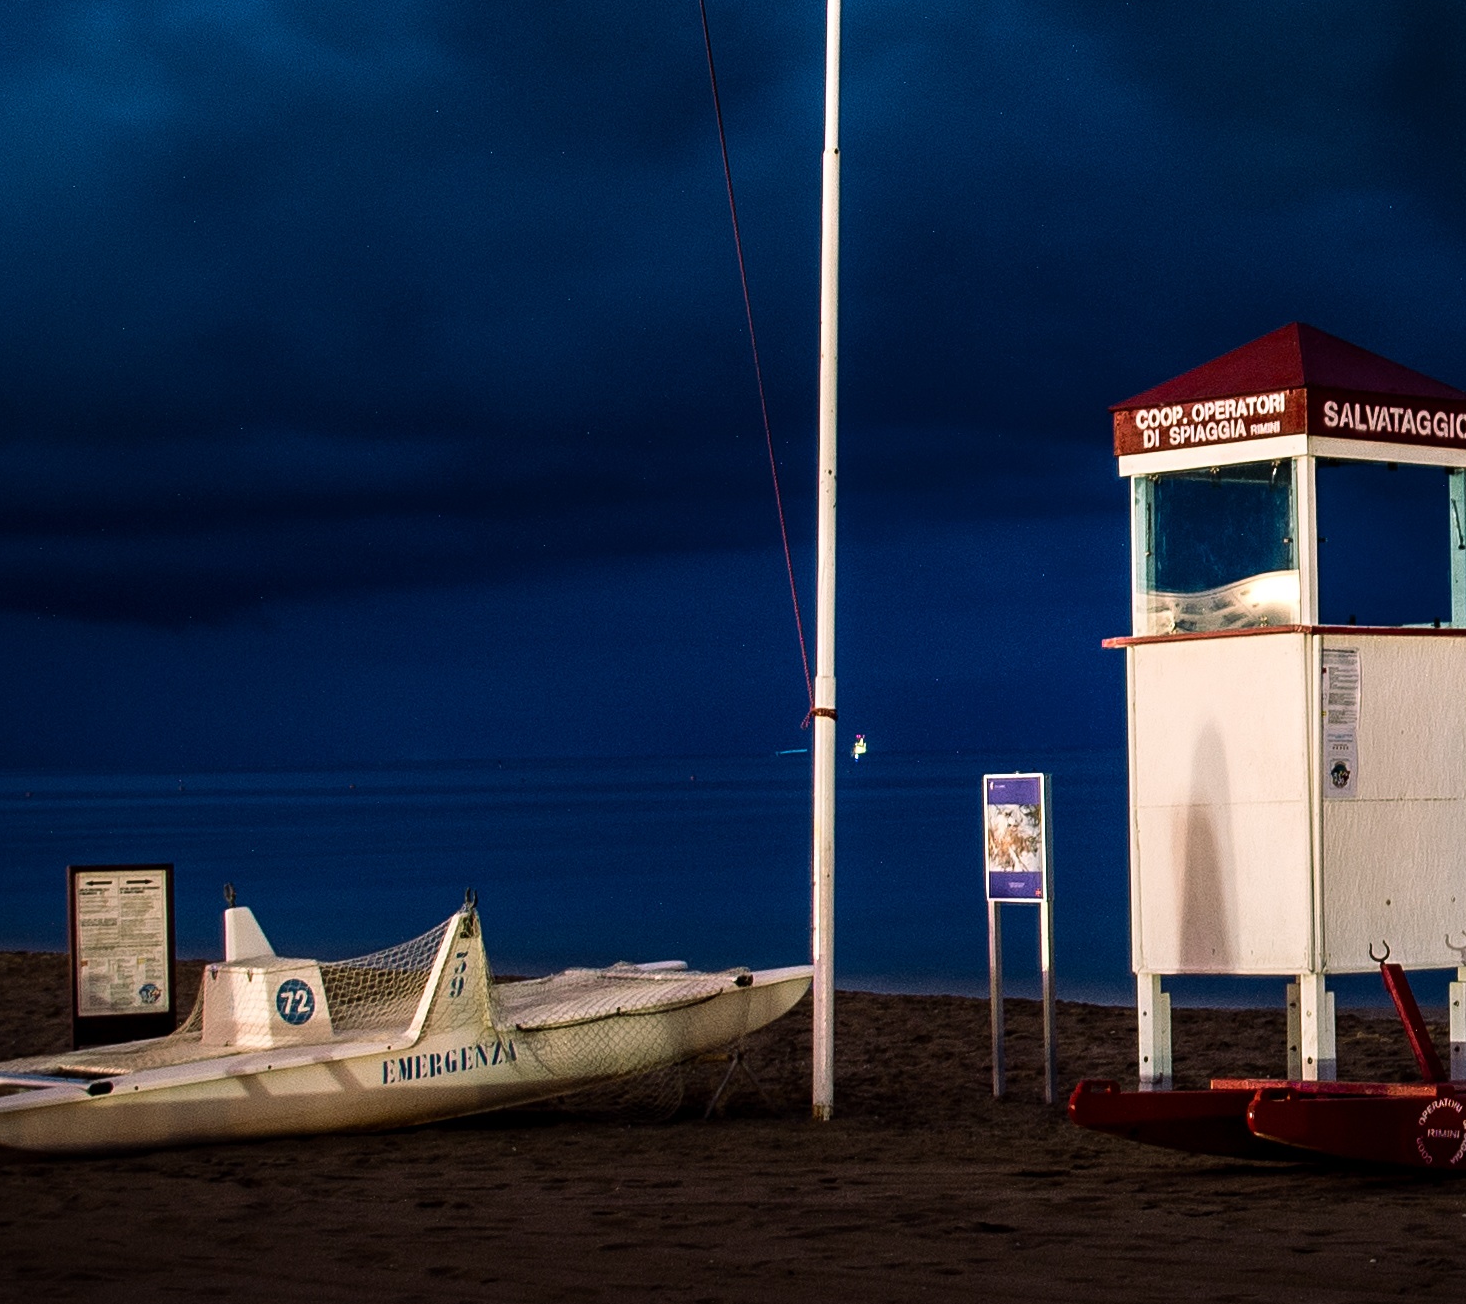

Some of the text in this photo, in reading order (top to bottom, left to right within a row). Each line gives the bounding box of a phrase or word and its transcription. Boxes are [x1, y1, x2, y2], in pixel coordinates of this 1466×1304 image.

[1135, 392, 1285, 430] COOP. OPERATORI
[1143, 428, 1160, 449] DI
[1169, 418, 1247, 445] SPIAGGIA
[280, 989, 311, 1015] 72
[383, 1039, 517, 1085] EMERGENZA
[1418, 1097, 1464, 1126] OPERATORI
[1427, 1128, 1461, 1139] RIMINI
